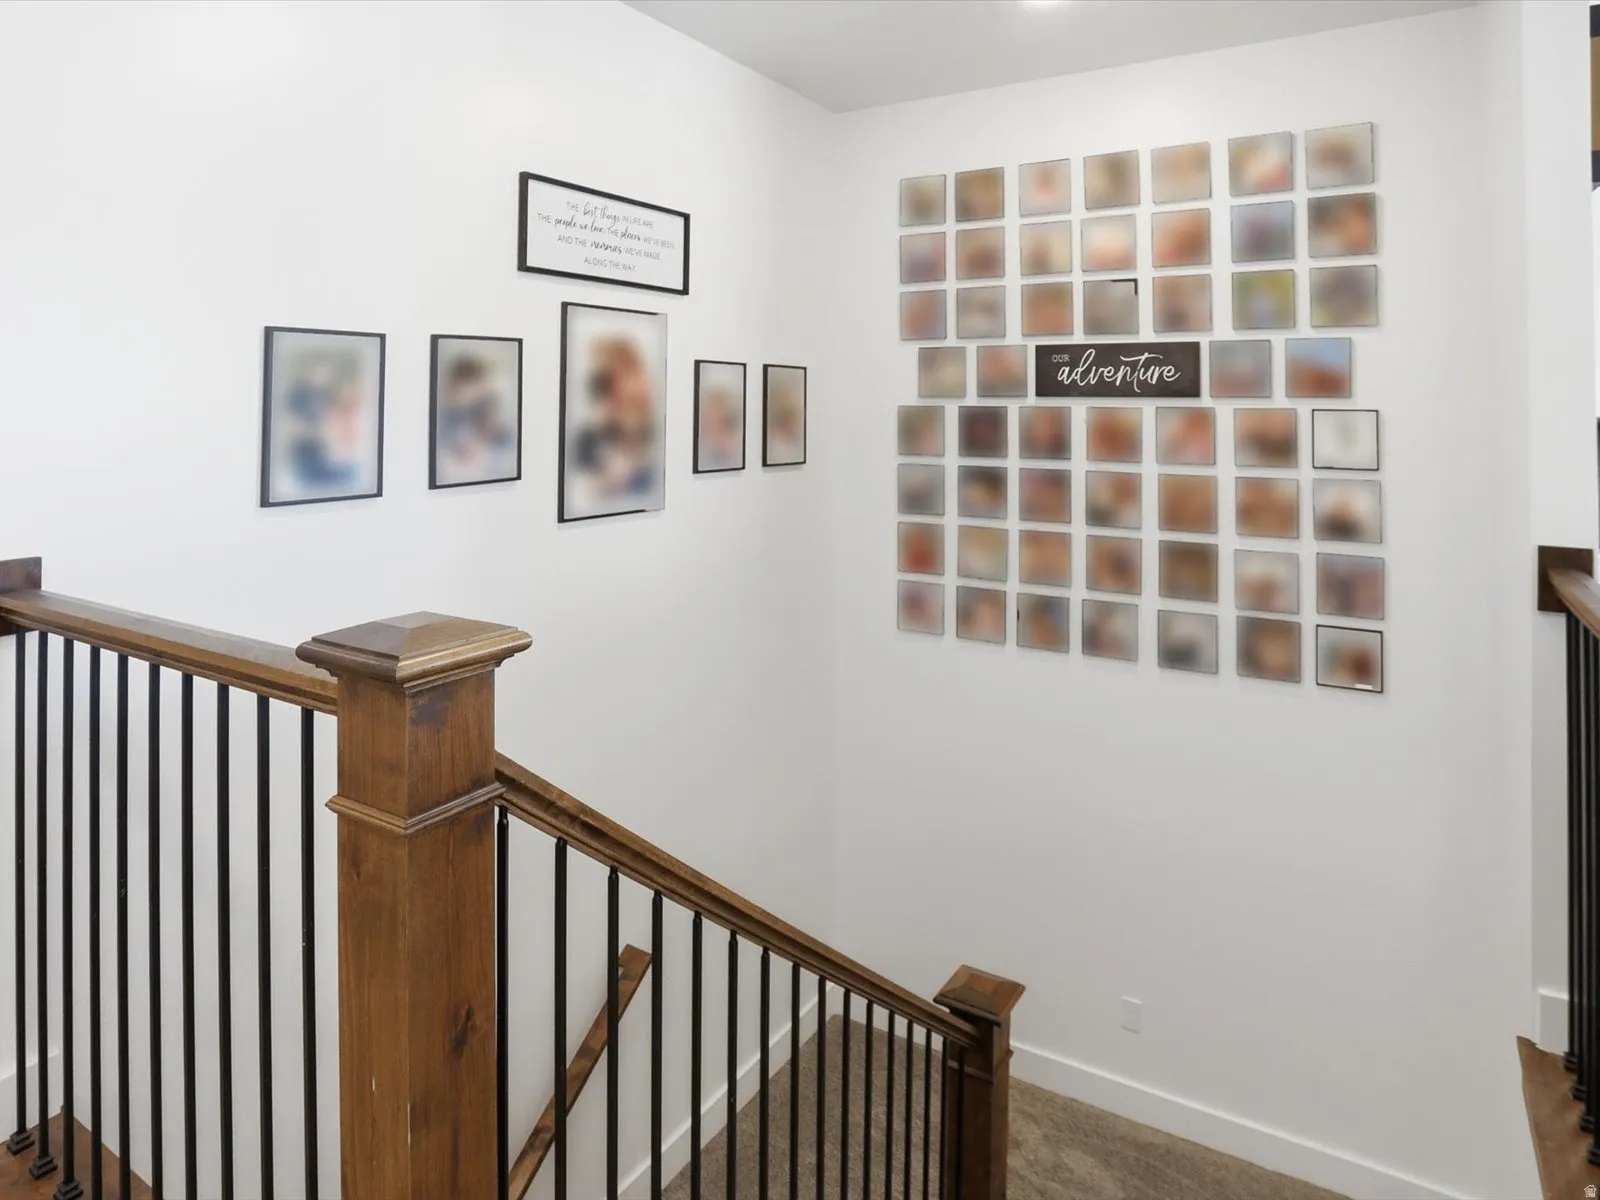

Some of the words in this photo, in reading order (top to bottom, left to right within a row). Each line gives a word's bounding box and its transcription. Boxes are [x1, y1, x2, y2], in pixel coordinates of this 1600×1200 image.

[536, 212, 552, 224] THE
[554, 214, 577, 230] people
[607, 227, 620, 238] THE
[620, 225, 641, 241] places
[566, 201, 580, 213] THE
[583, 201, 598, 218] best
[598, 205, 620, 229] things
[622, 215, 629, 224] IN
[630, 216, 642, 227] LIFE
[642, 220, 654, 229] ARE
[557, 234, 573, 245] AND
[575, 237, 587, 248] THE
[590, 240, 622, 255] memories
[643, 251, 661, 261] MADE
[584, 256, 608, 268] ALONG
[608, 260, 621, 270] THE
[1052, 354, 1071, 363] OUR
[1057, 348, 1182, 393] adventure
